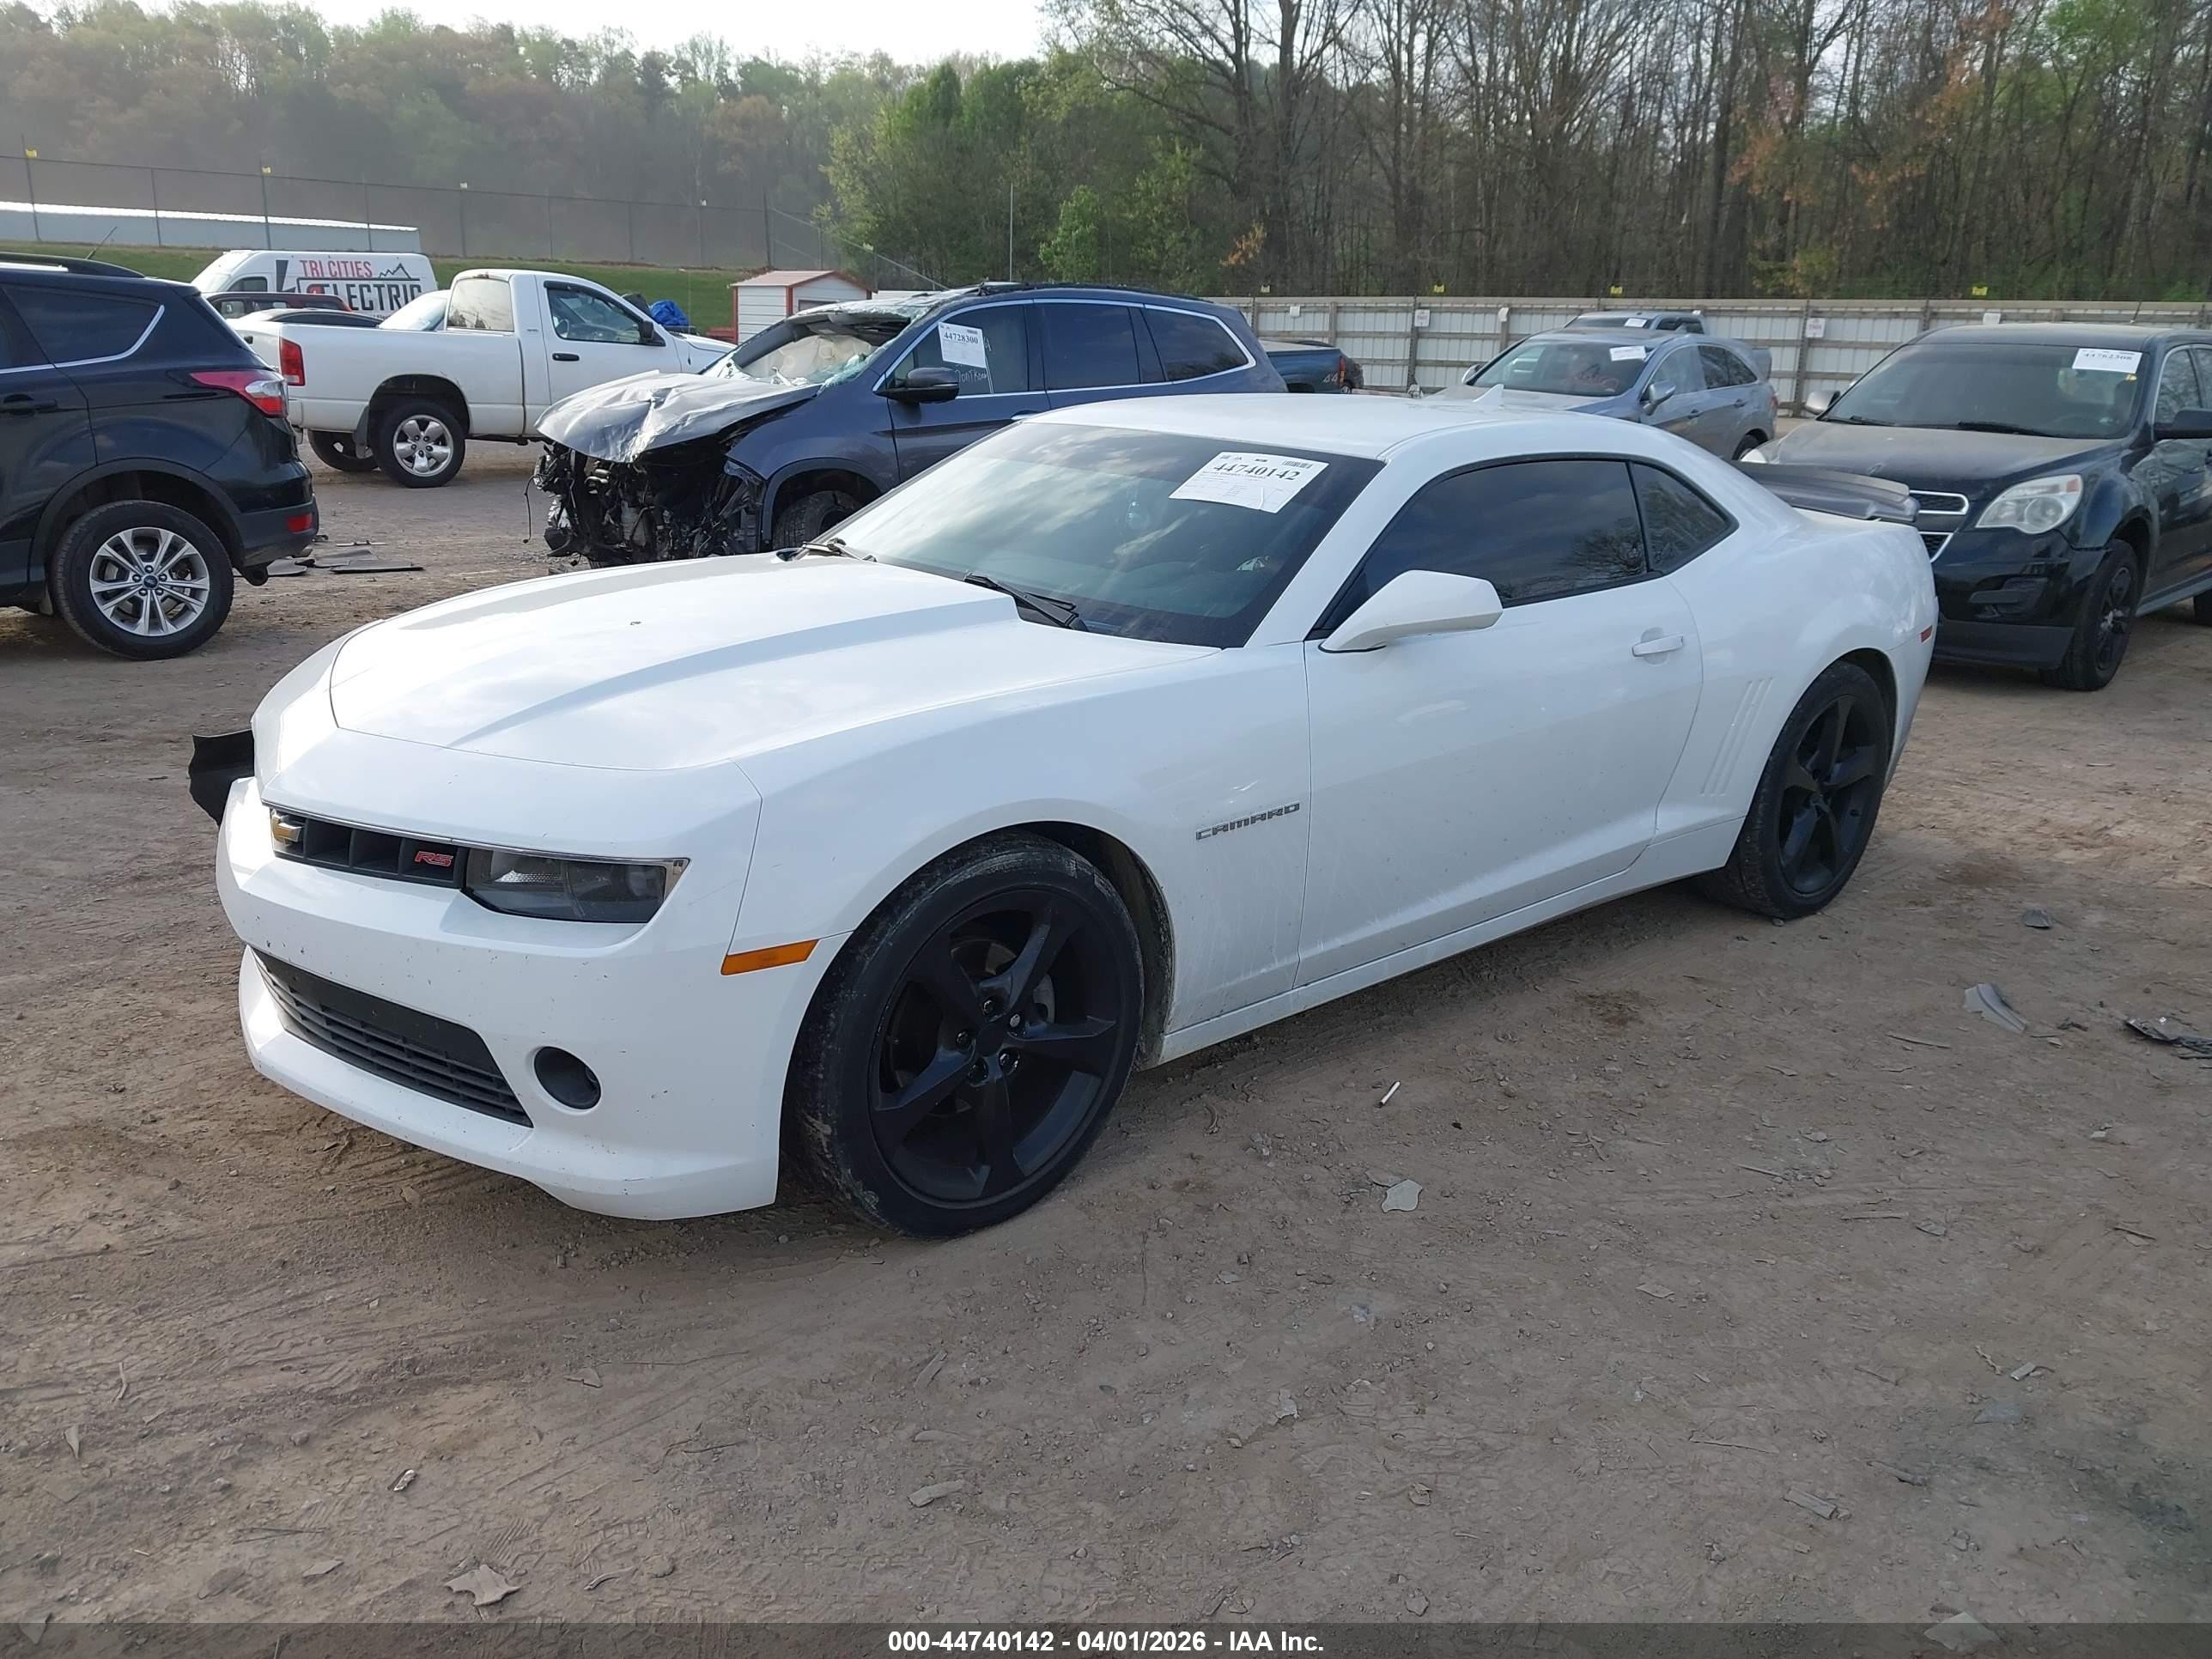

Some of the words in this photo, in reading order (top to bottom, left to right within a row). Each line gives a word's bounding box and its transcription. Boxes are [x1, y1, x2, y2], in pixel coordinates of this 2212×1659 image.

[299, 259, 325, 277] TRI
[327, 260, 373, 278] CITIES
[944, 331, 979, 344] 44728300
[1212, 463, 1301, 481] 44740142
[1195, 801, 1300, 841] CAMARO
[415, 851, 453, 866] RS
